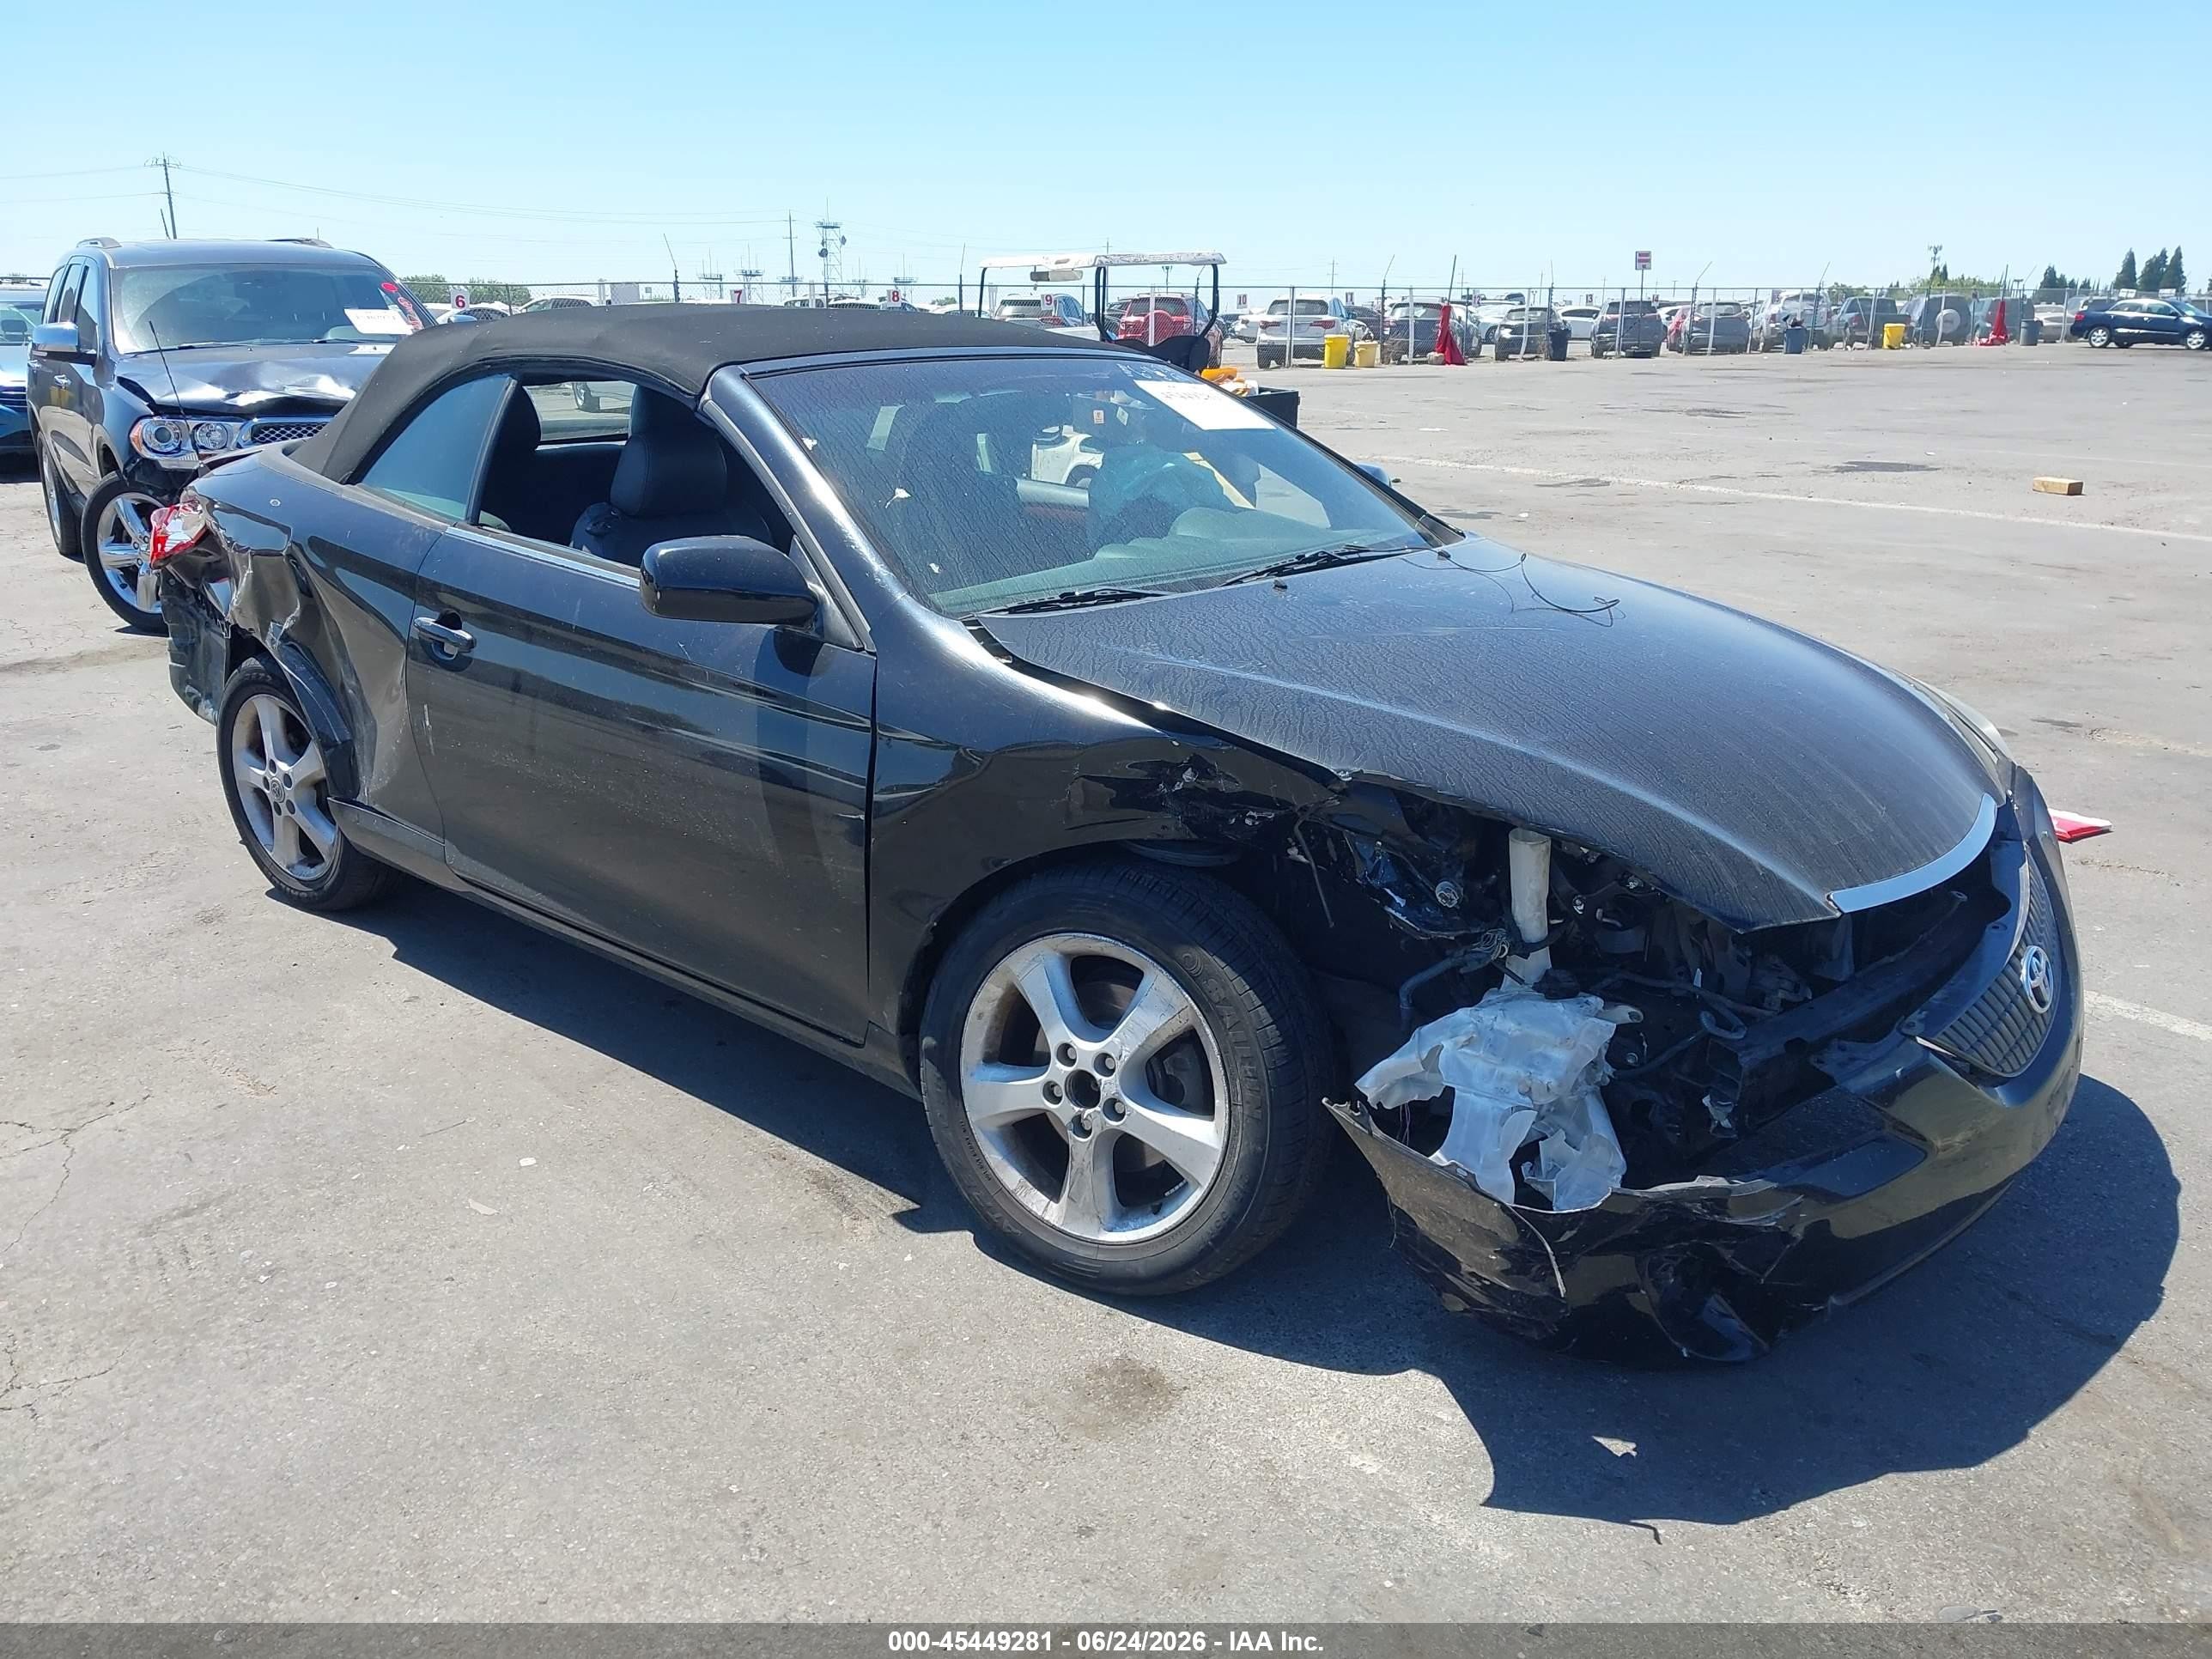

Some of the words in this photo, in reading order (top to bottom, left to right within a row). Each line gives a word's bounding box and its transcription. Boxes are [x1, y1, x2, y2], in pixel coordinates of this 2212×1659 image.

[455, 295, 466, 308] 6
[733, 289, 743, 304] 7
[891, 290, 900, 303] 8
[1044, 294, 1053, 306] 9
[1238, 294, 1248, 305] 10
[1585, 294, 1594, 303] 13
